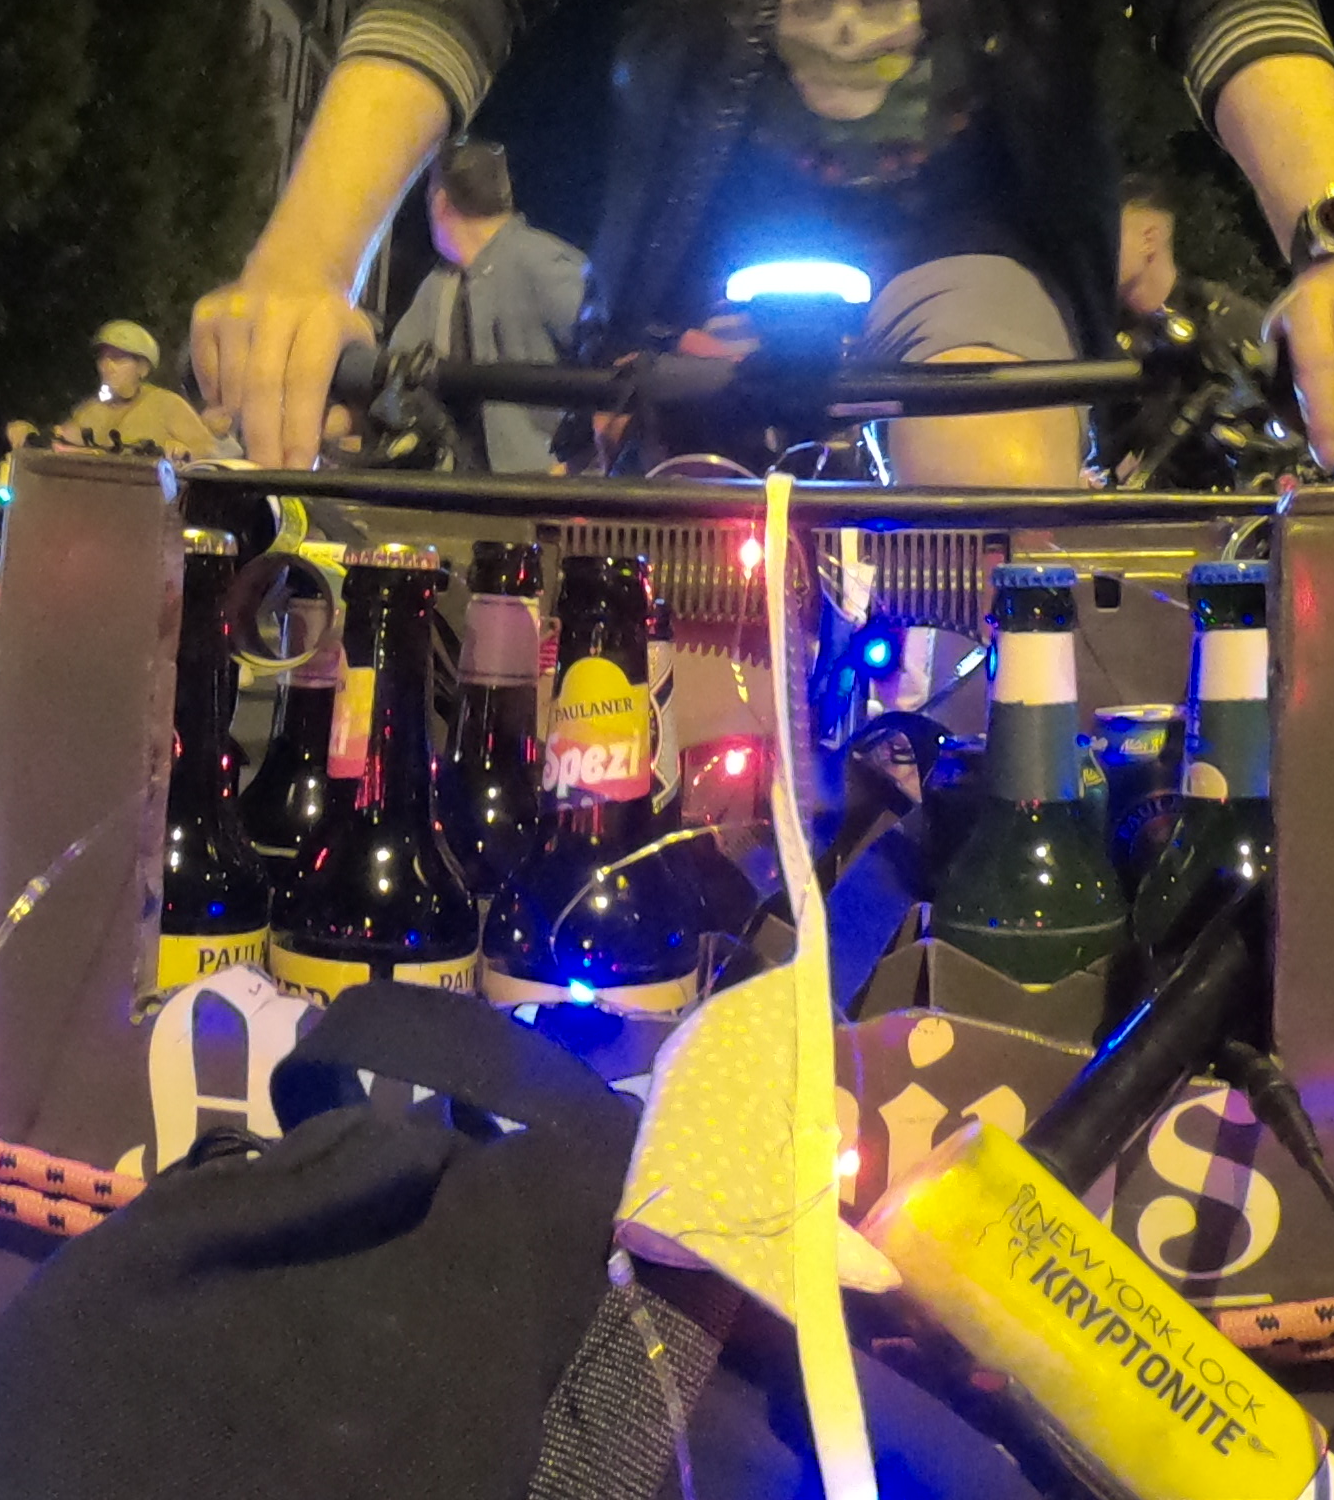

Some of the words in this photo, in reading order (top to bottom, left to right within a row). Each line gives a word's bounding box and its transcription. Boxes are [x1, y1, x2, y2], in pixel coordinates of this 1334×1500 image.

[542, 728, 640, 799] Spezi
[555, 697, 633, 723] PAULANER
[1027, 1201, 1104, 1271] NEW
[1105, 1266, 1181, 1348] YORK
[1182, 1342, 1265, 1424] LOCK
[1029, 1256, 1246, 1456] KRYPTONITE
